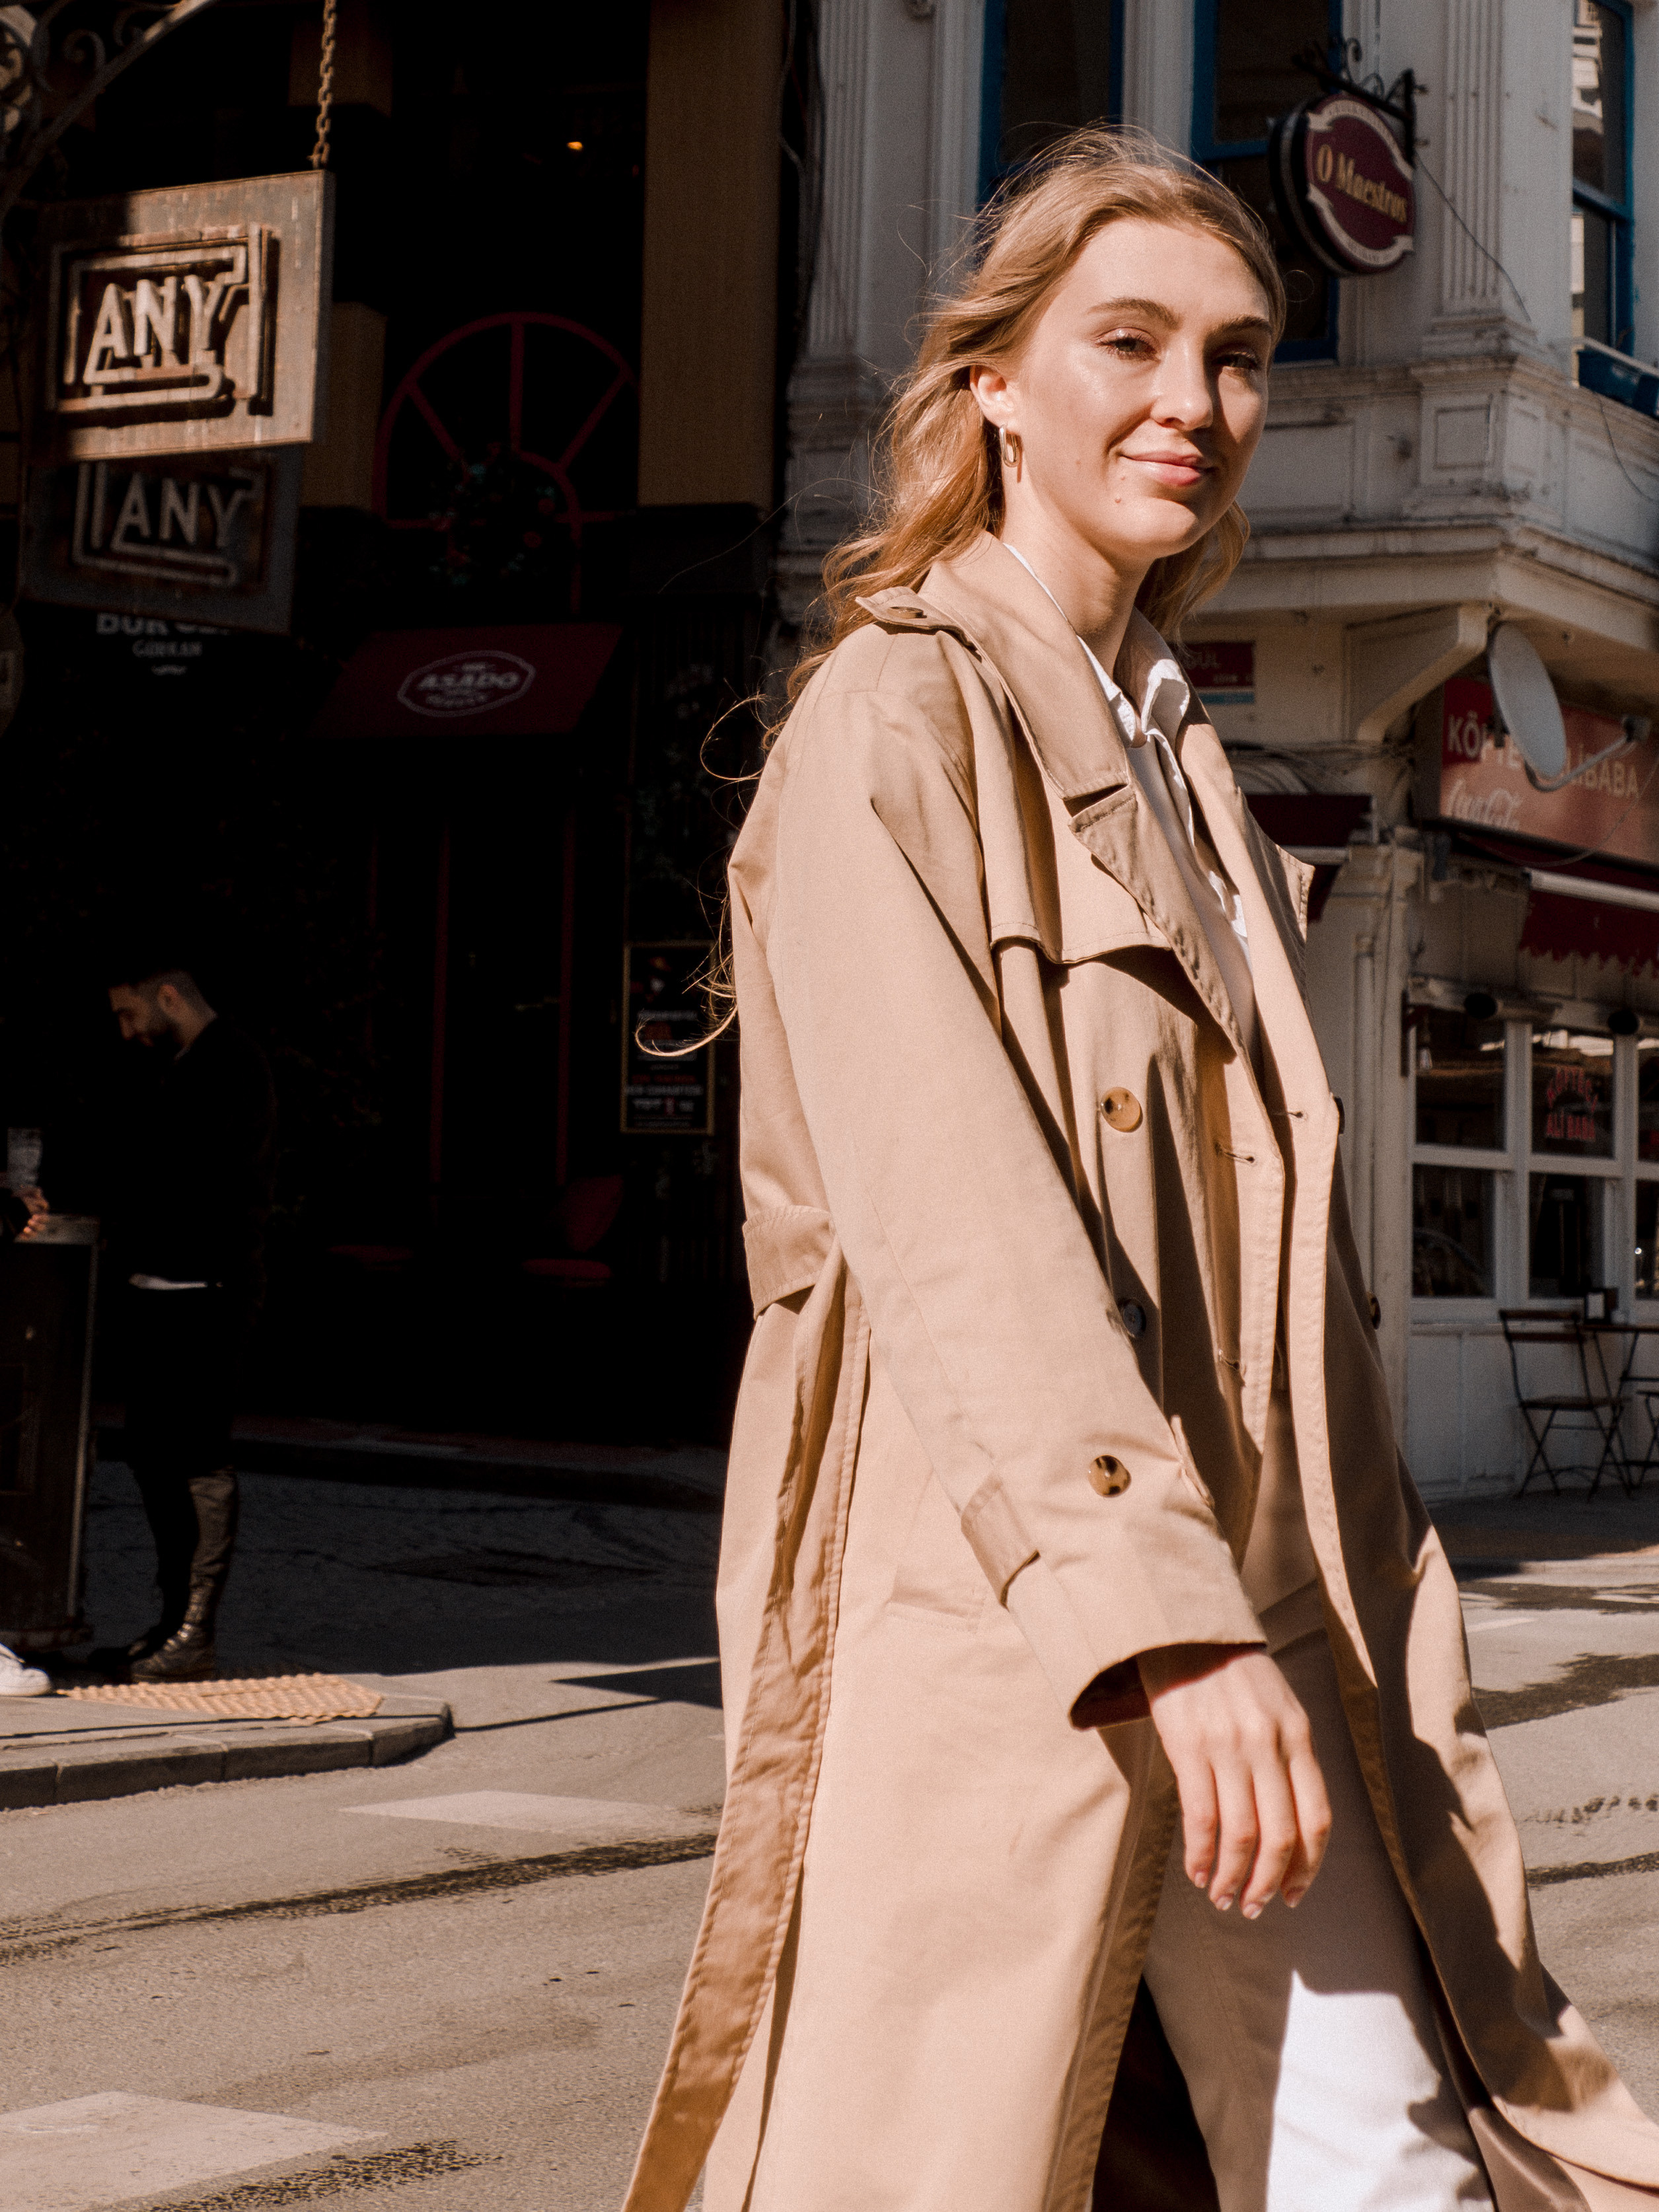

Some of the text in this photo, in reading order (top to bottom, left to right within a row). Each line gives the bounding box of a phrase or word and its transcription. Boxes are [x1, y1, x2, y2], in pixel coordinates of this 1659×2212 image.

[85, 275, 228, 383] ANY
[110, 472, 245, 552] ANY
[95, 612, 232, 636] BUR
